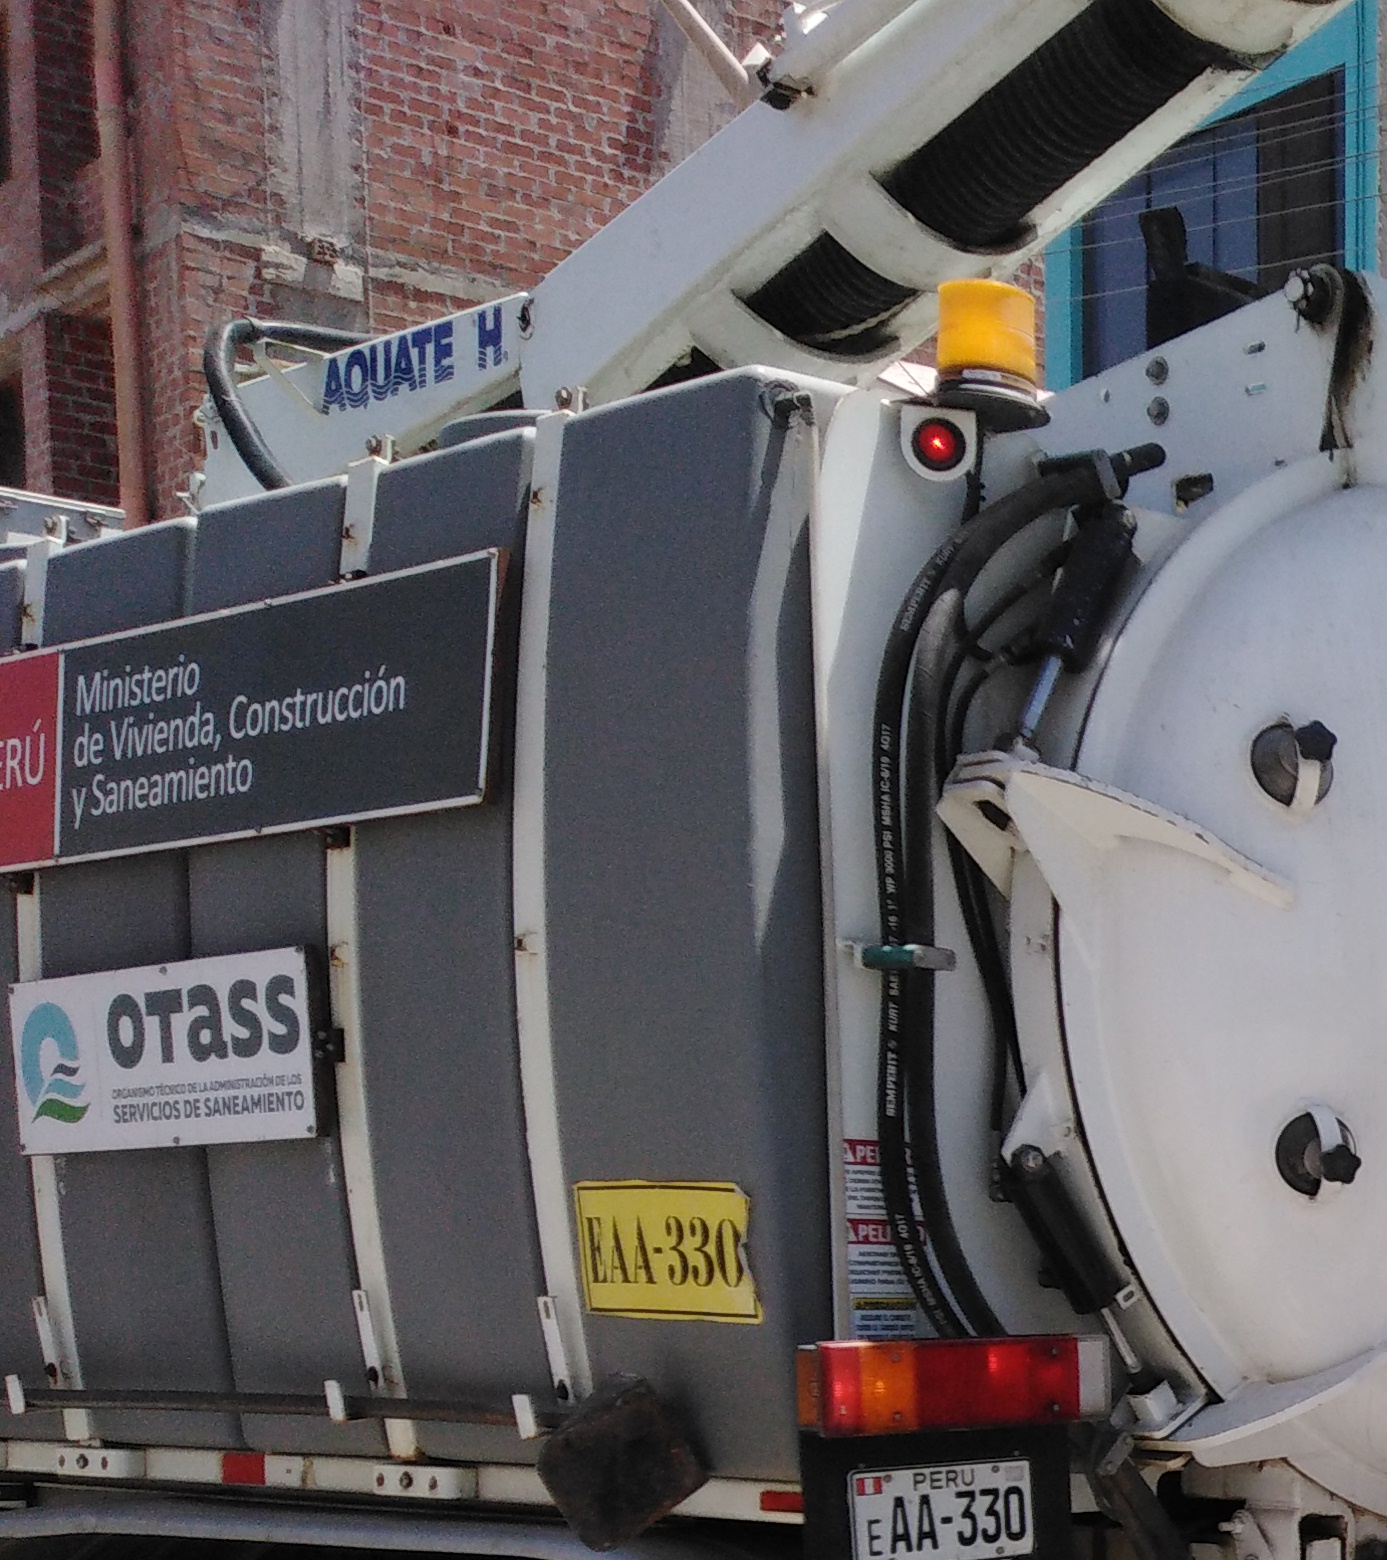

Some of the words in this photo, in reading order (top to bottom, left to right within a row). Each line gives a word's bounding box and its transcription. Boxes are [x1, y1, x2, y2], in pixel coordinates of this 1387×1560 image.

[73, 722, 104, 768] de
[110, 701, 222, 761] Vivienda,
[229, 664, 406, 740] Construcción
[75, 653, 200, 717] Ministerio
[0, 718, 45, 790] RÚ
[72, 787, 87, 830] y
[90, 754, 253, 817] Saneamiento
[112, 1084, 156, 1100] ORGANISMO
[187, 1081, 198, 1094] DE
[275, 1075, 286, 1086] DE
[113, 1100, 182, 1124] SERVICIOS
[183, 1097, 201, 1119] DE
[204, 1089, 305, 1118] SANEAMIENTO
[585, 1215, 744, 1289] EAA-330
[912, 1469, 976, 1491] PERU
[867, 1486, 1026, 1556] EAA-330
